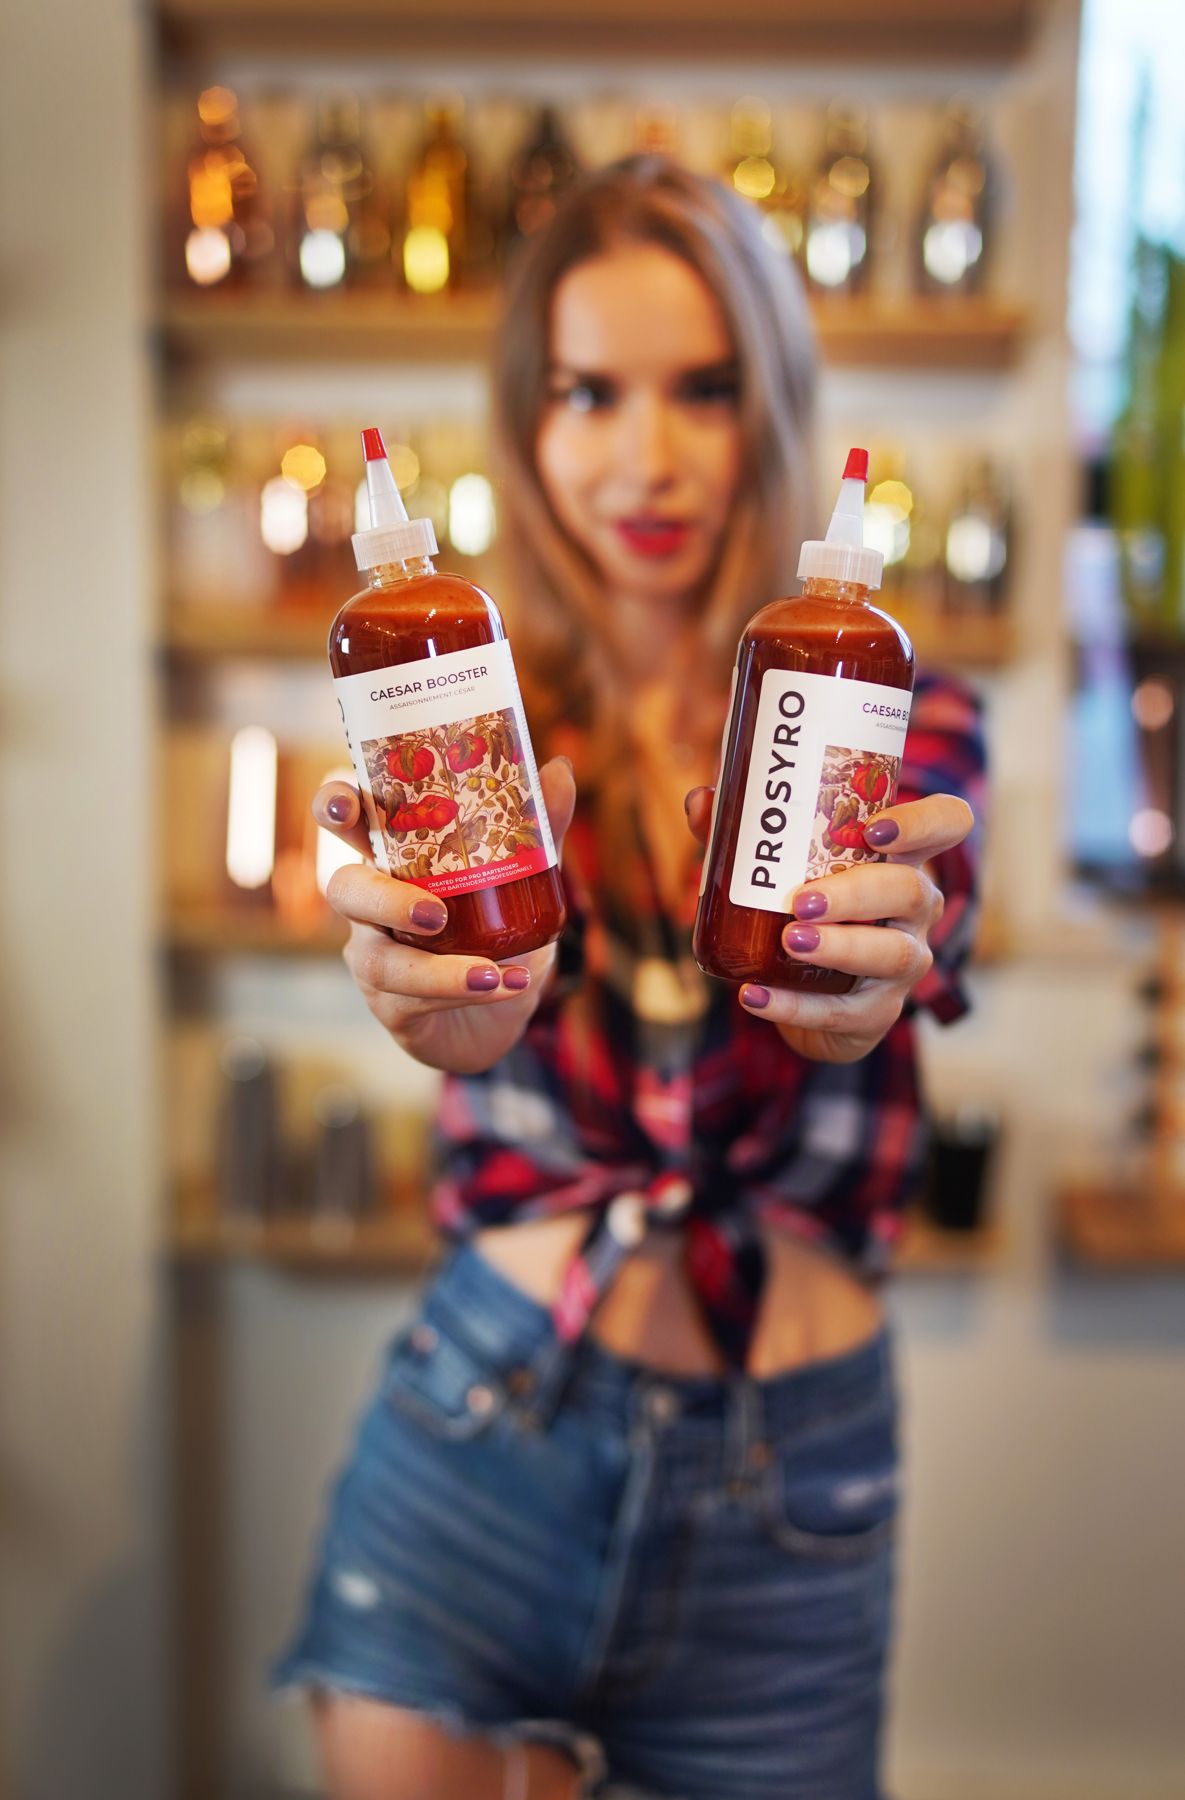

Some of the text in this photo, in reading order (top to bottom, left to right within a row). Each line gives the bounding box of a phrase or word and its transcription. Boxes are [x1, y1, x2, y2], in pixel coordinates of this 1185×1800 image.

[370, 666, 488, 702] CAESAR BOOSTER
[389, 691, 452, 710] ASSAISONNEMENT
[862, 702, 902, 720] CAESAR
[750, 690, 806, 889] PROSYRO
[427, 862, 519, 889] CREATED FOR PRO BARTENDERS
[447, 879, 487, 891] BARTENDERS
[487, 864, 533, 882] PROFESSIONNELS
